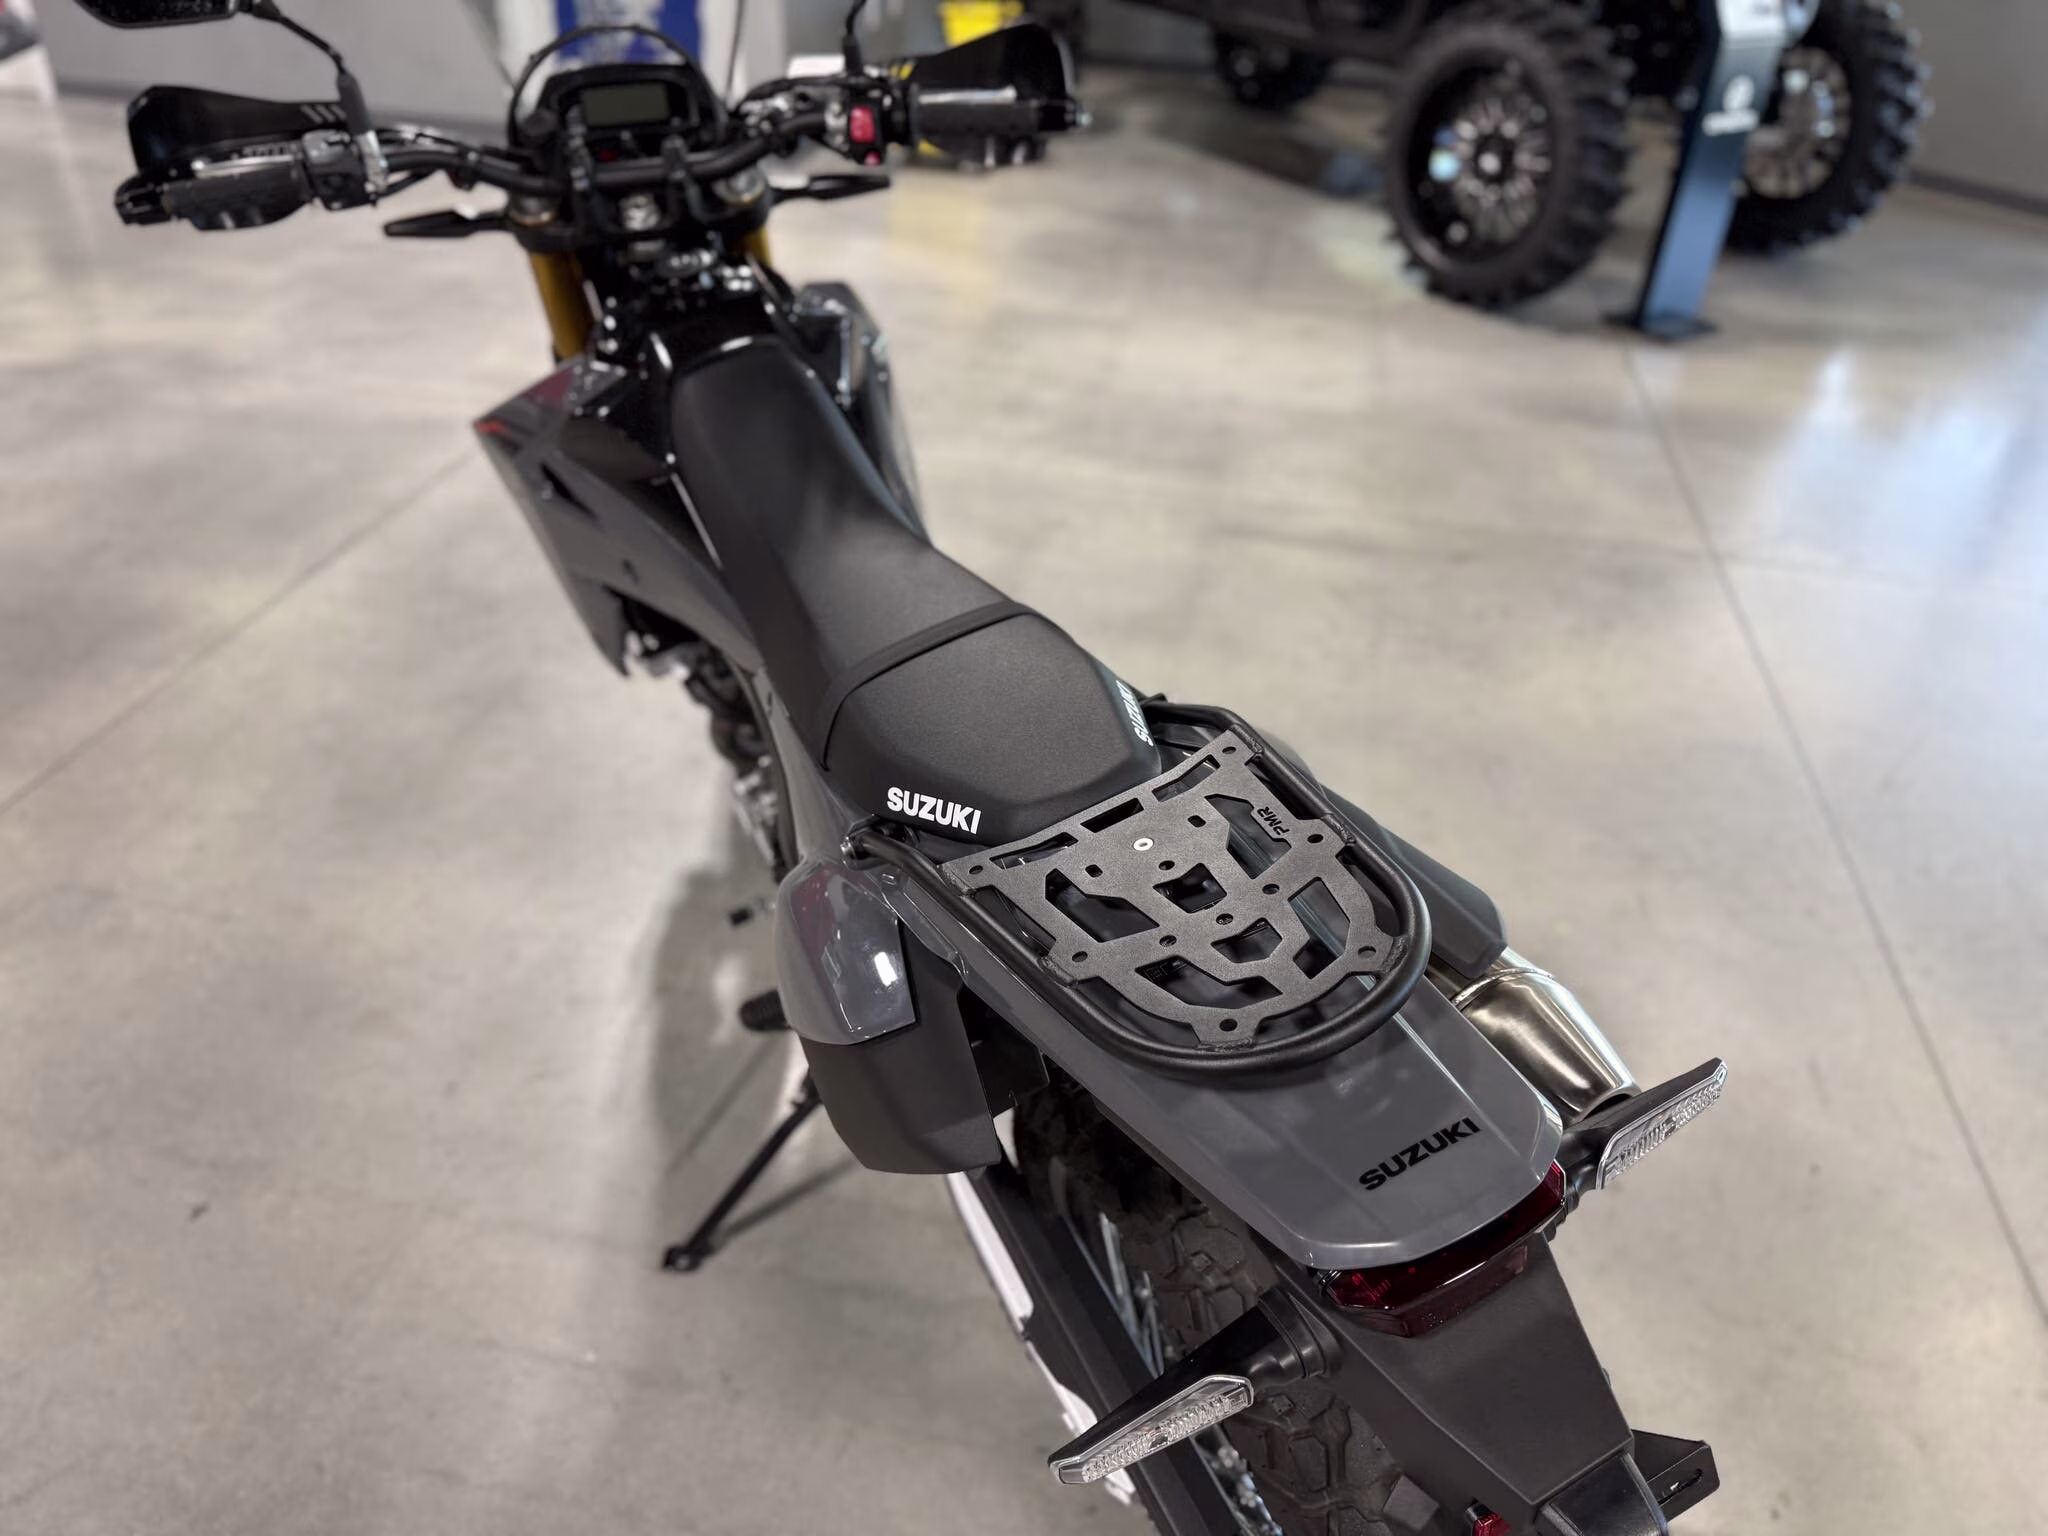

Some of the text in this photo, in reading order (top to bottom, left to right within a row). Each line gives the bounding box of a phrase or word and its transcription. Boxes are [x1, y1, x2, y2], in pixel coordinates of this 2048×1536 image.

[1116, 680, 1154, 747] SUZUKI
[887, 786, 982, 835] SUZUKI
[1256, 806, 1290, 836] PMR
[1358, 1116, 1481, 1191] SUZUKI
